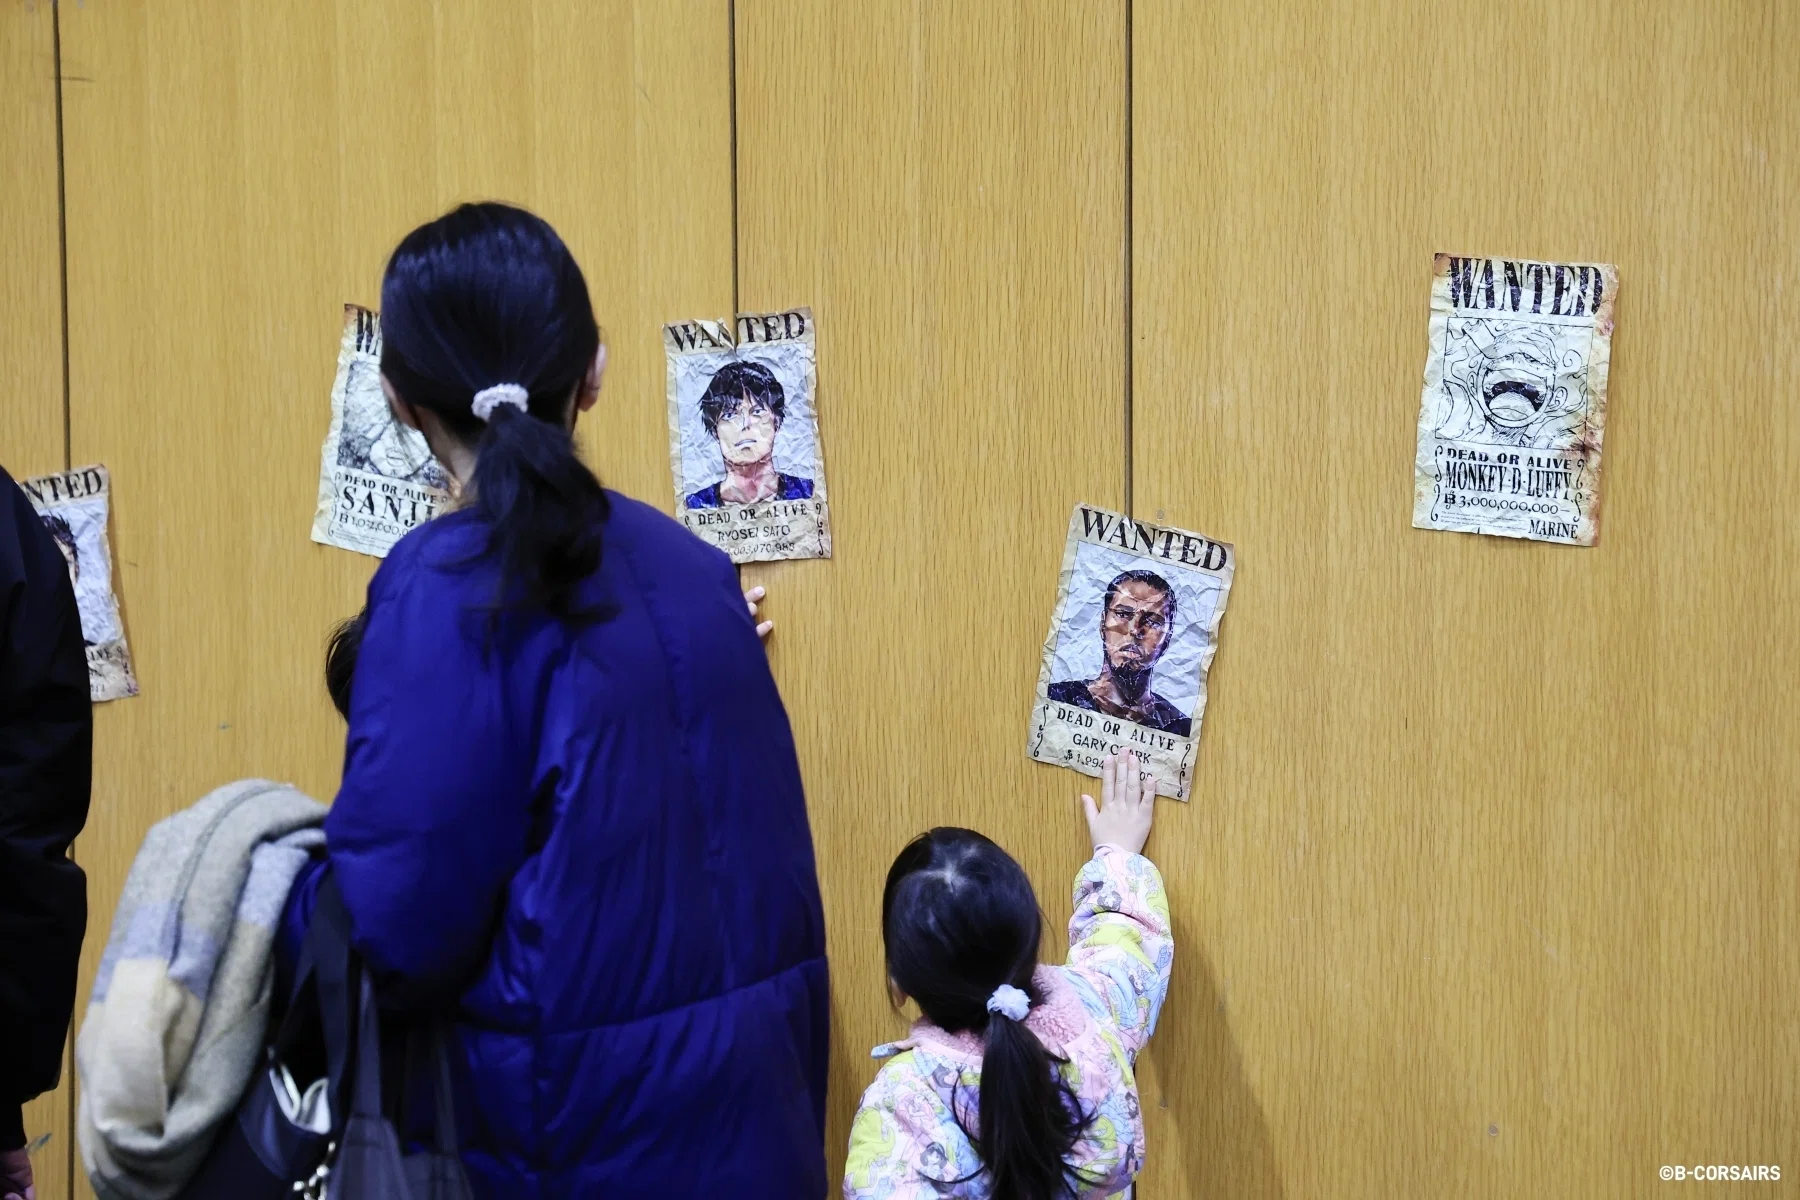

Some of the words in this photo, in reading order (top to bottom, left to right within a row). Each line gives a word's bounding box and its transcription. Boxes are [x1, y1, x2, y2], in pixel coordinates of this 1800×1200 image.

[1448, 256, 1604, 317] WANTED
[1447, 448, 1489, 463] DEAD
[1497, 452, 1520, 466] OR
[1527, 456, 1572, 470] ALIVE
[23, 468, 102, 505] NTED
[344, 474, 376, 490] DEAD
[381, 483, 398, 495] OR
[404, 487, 438, 504] ALIVE
[341, 486, 436, 528] SANJI
[698, 512, 731, 526] DEAD
[739, 508, 757, 521] OR
[766, 502, 808, 518] ALIVE
[717, 527, 759, 543] RYOSEI
[763, 524, 791, 538] SATO
[1080, 507, 1228, 572] WANTED
[1528, 519, 1579, 540] MARINE
[1056, 707, 1094, 728] DEAD
[1102, 720, 1121, 736] OR
[1129, 728, 1177, 751] ALIVE
[1072, 733, 1107, 752] GARY
[1110, 743, 1152, 765] CRK
